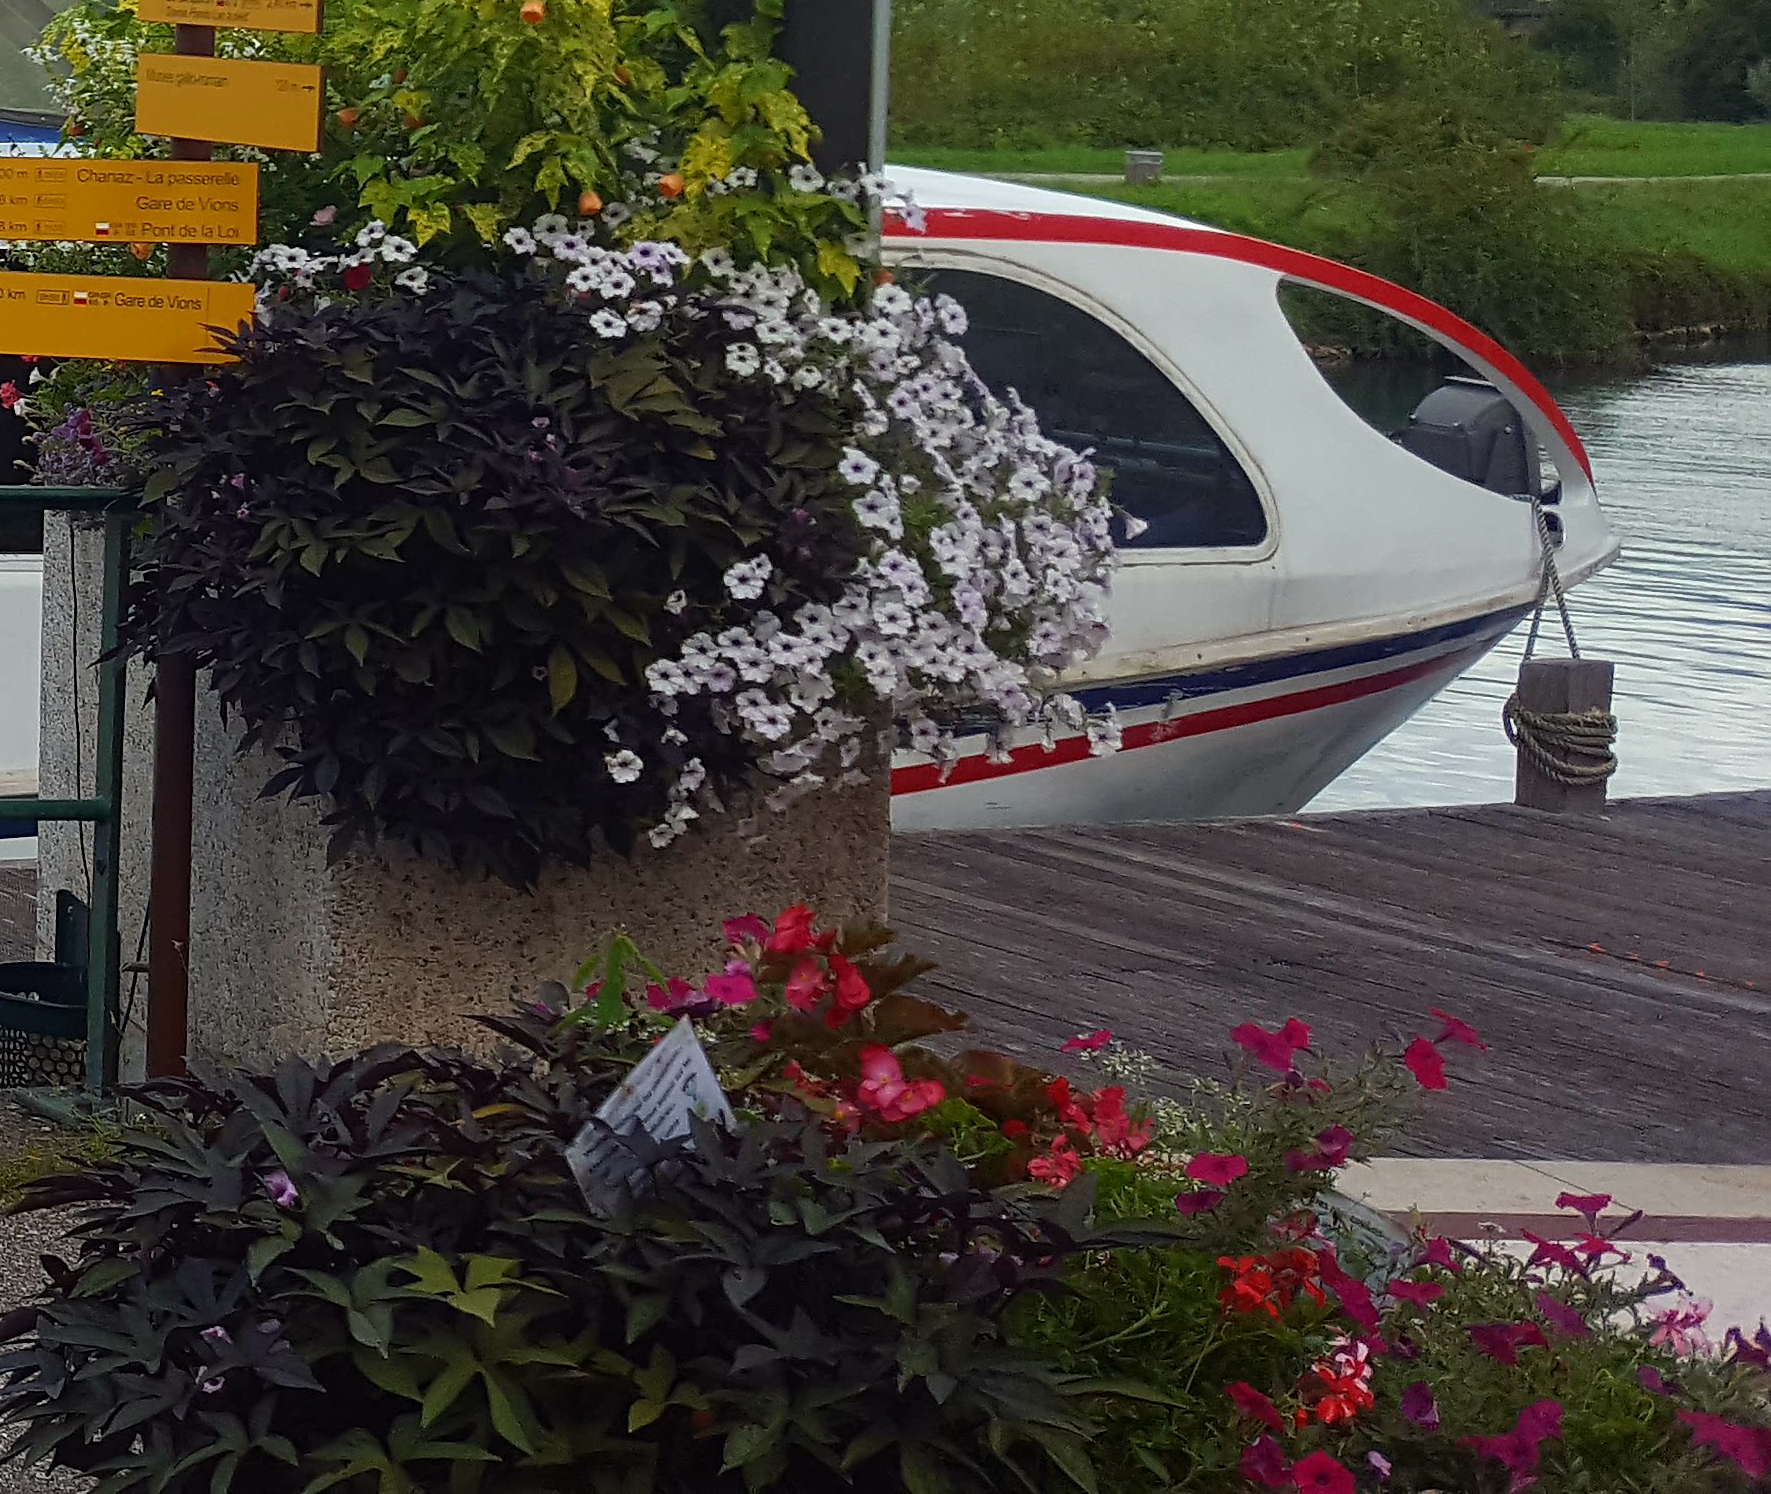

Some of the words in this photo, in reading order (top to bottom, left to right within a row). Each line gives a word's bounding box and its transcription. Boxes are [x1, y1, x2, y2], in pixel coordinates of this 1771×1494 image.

[77, 168, 134, 184] Chanaz
[146, 169, 163, 184] La
[168, 171, 239, 186] passerelle
[136, 195, 172, 210] Gare
[176, 197, 194, 211] de
[198, 196, 239, 212] Vions
[9, 221, 28, 233] km
[141, 222, 174, 237] Pont
[179, 223, 197, 238] de
[201, 224, 214, 238] la
[7, 287, 26, 300] km
[114, 293, 145, 308] Gare
[148, 294, 164, 309] de
[167, 295, 202, 311] Vions
